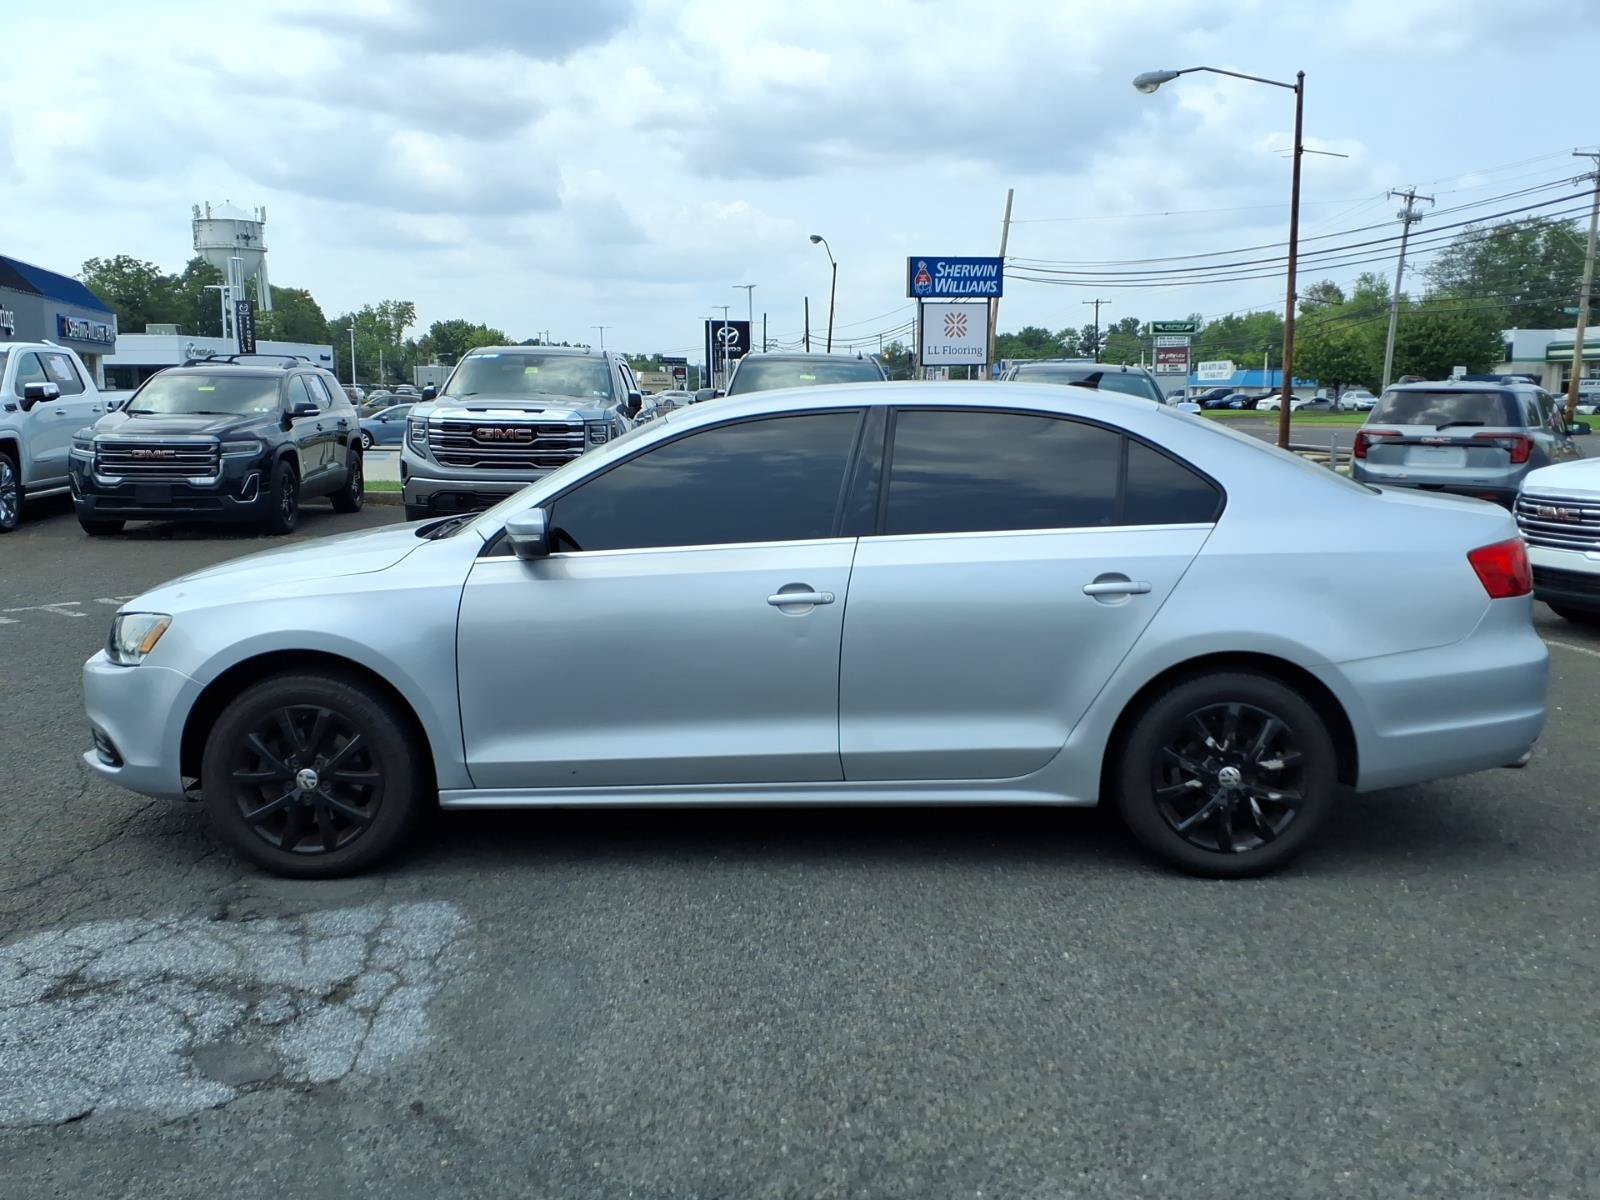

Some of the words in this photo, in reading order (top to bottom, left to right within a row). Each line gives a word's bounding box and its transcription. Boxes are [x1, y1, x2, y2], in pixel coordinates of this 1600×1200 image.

[935, 261, 998, 278] SHERWIN
[934, 278, 998, 293] WILLIAMS
[927, 345, 940, 355] LL
[942, 345, 983, 357] Flooring
[476, 427, 533, 440] GMC
[131, 449, 176, 458] GMC
[1535, 504, 1581, 521] GMC
